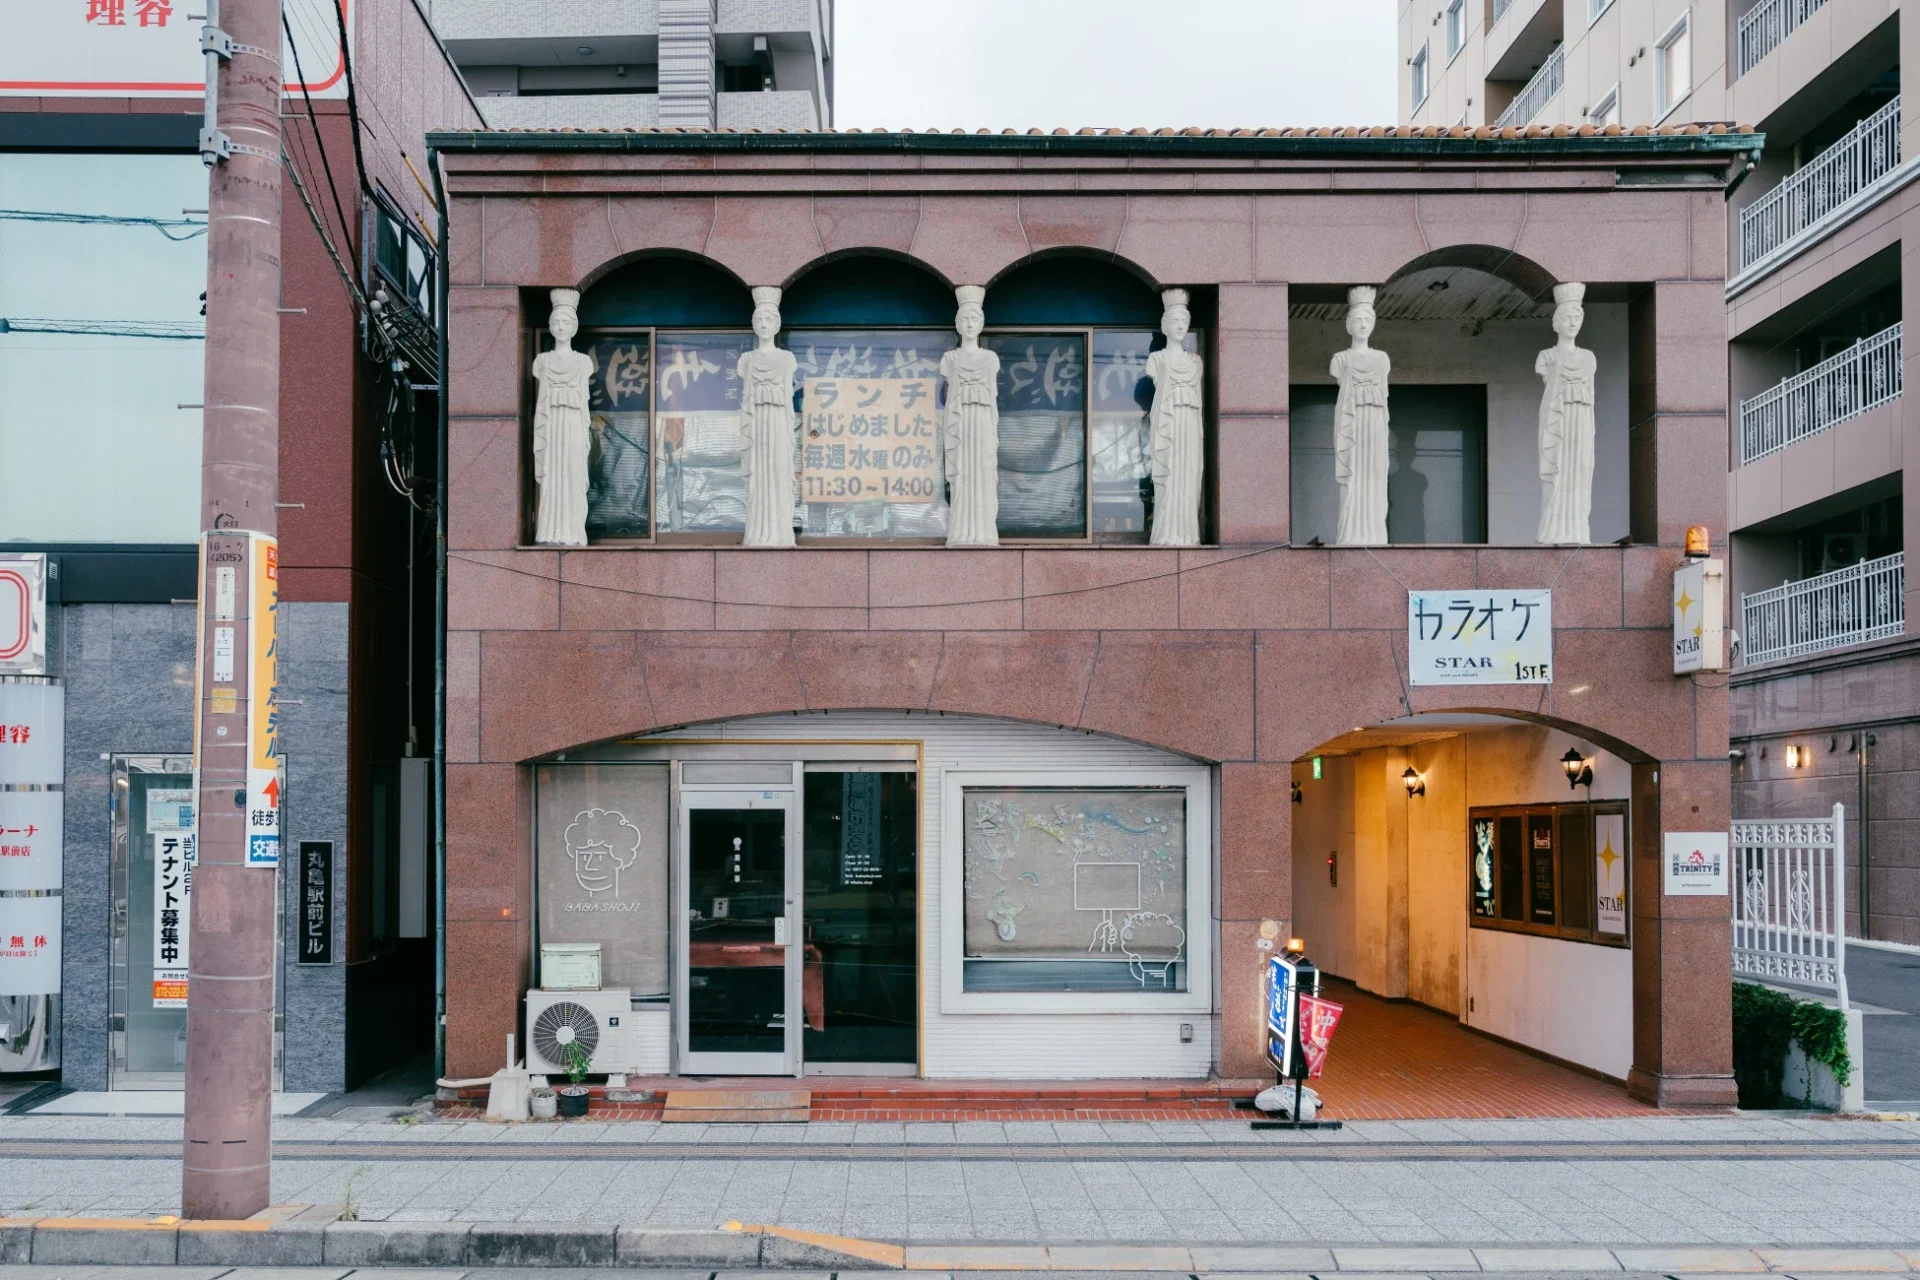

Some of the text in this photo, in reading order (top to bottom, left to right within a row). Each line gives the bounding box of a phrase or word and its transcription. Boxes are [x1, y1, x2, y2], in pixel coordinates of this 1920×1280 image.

[813, 382, 927, 409] ランチ
[806, 413, 933, 437] はじめました
[804, 443, 933, 470] 毎週水曜のみ
[1415, 598, 1540, 641] カラオケ
[1676, 636, 1700, 656] STAR
[1435, 657, 1493, 668] STAR
[1, 845, 31, 857] 駅前店
[1680, 865, 1713, 873] TRINITY
[160, 838, 179, 963] テナント募集中
[306, 850, 325, 954] 丸亀駅前ビル
[1598, 896, 1624, 912] STAR
